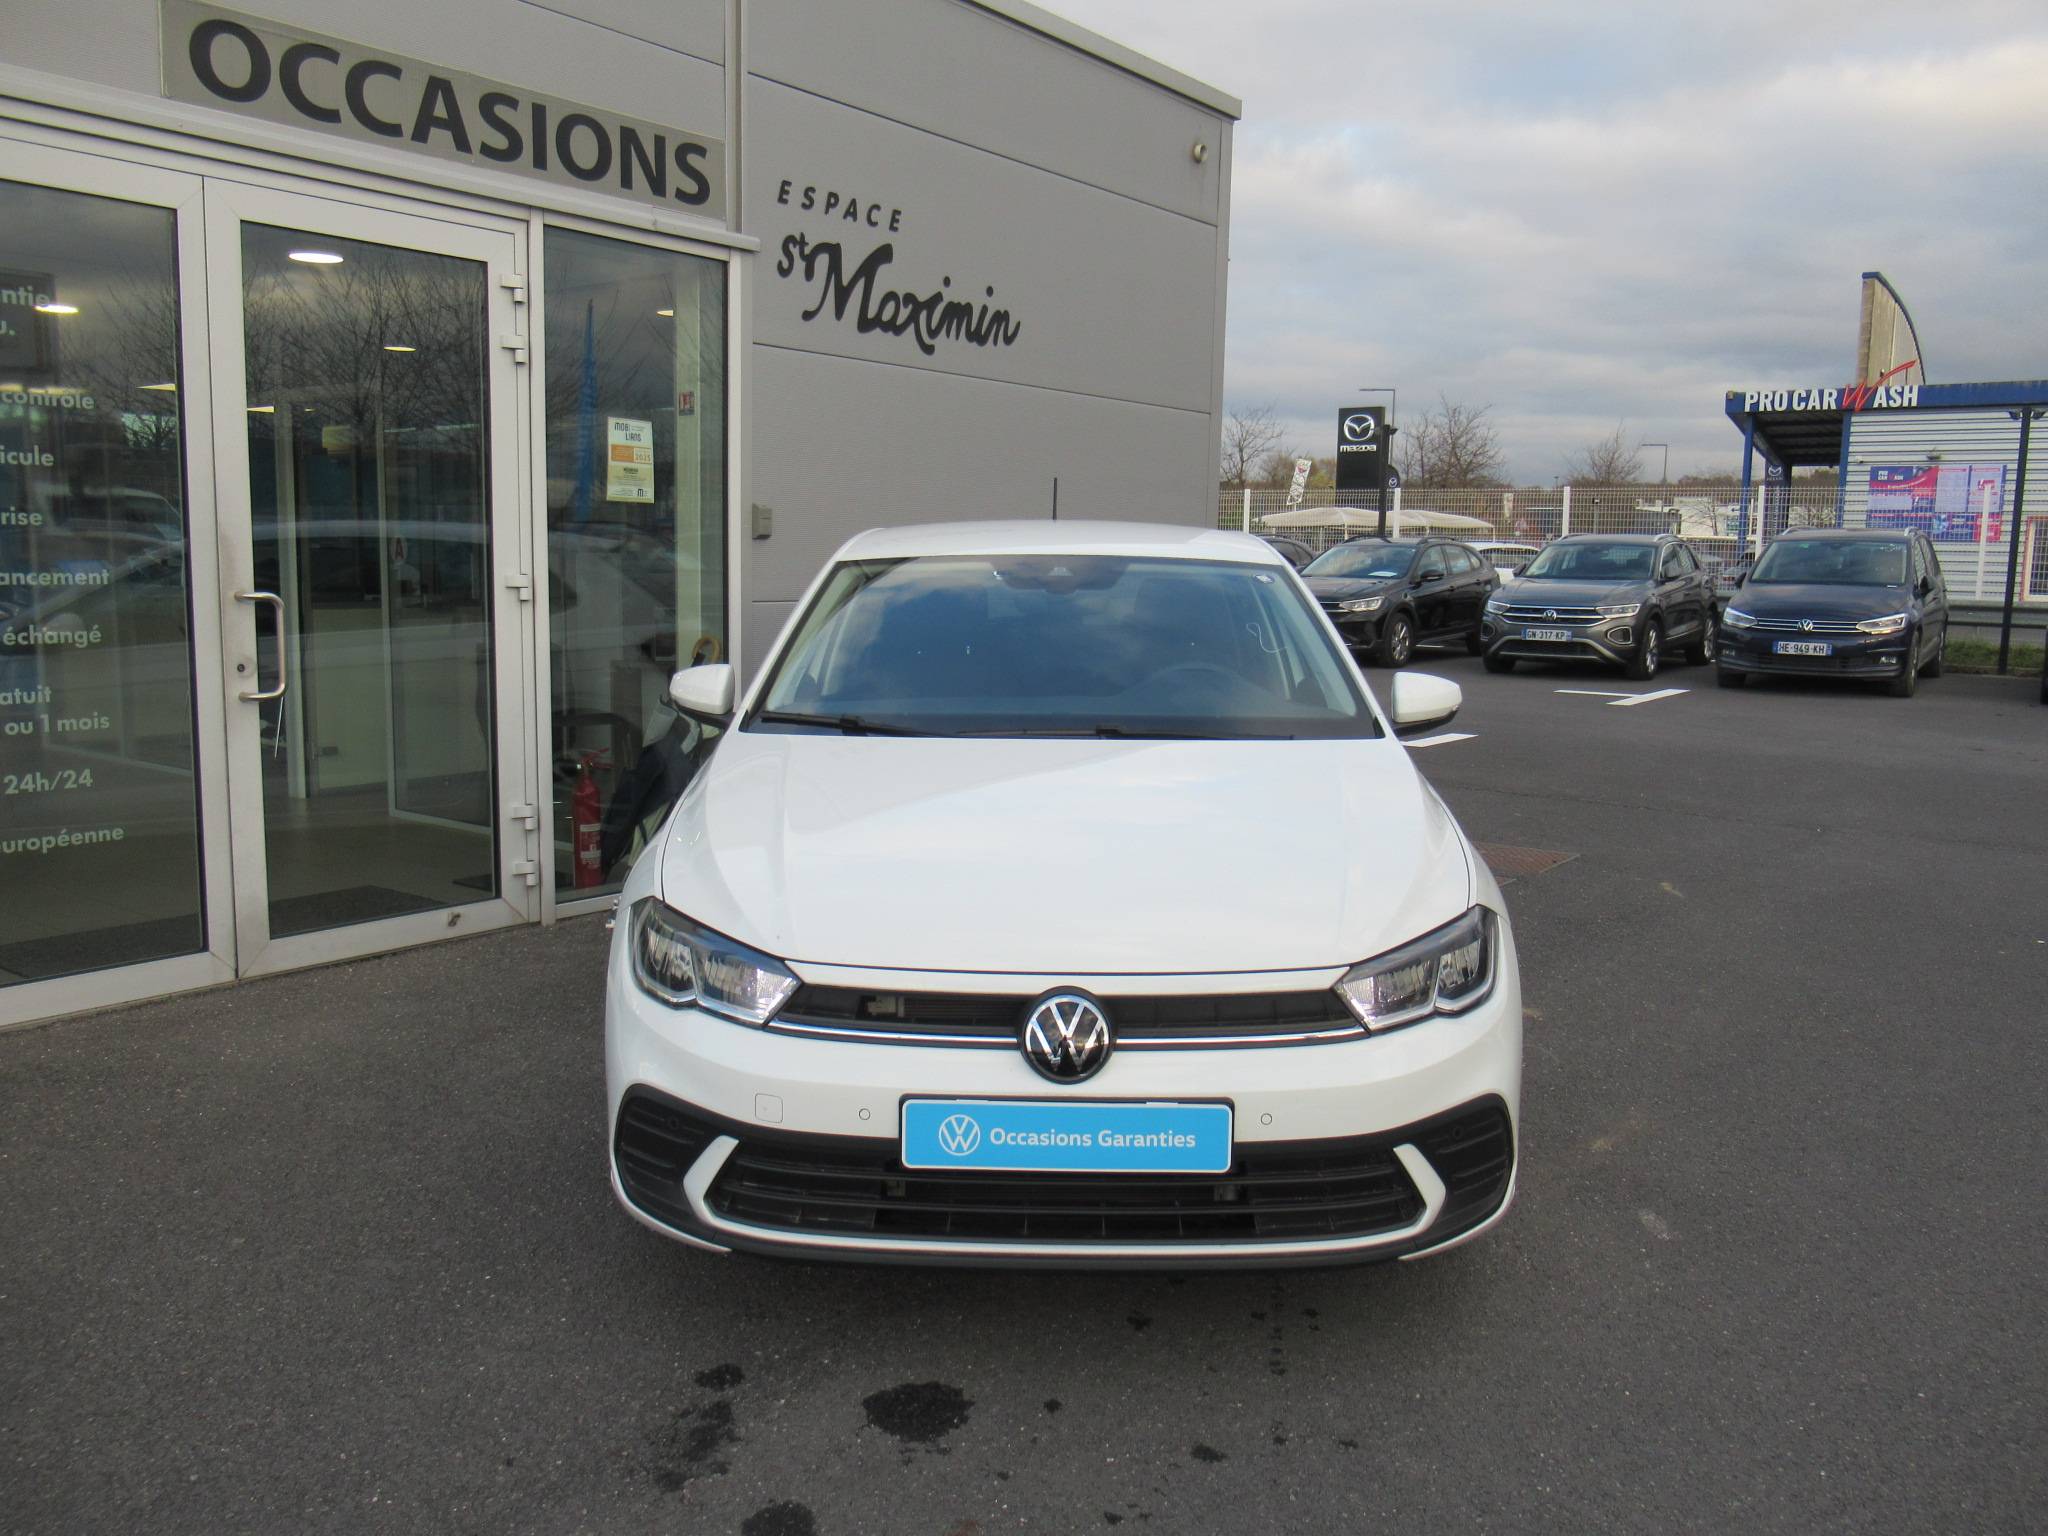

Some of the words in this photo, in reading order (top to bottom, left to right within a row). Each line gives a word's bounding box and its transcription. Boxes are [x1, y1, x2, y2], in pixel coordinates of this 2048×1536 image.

[188, 18, 711, 206] OCCASIONS
[776, 179, 902, 232] ESPACE
[801, 241, 1021, 356] Maximin
[1744, 390, 1788, 413] PRO
[1792, 387, 1838, 411] CAR
[1842, 361, 1919, 413] WASH
[1, 505, 43, 526] rise
[3, 624, 102, 649] échangé
[4, 720, 34, 736] ou
[39, 713, 51, 733] 1
[56, 711, 110, 732] mois
[3, 767, 94, 795] 24h/24
[0, 826, 125, 854] uropéenne
[989, 1127, 1092, 1147] Occasions
[1097, 1129, 1196, 1148] Garanties
